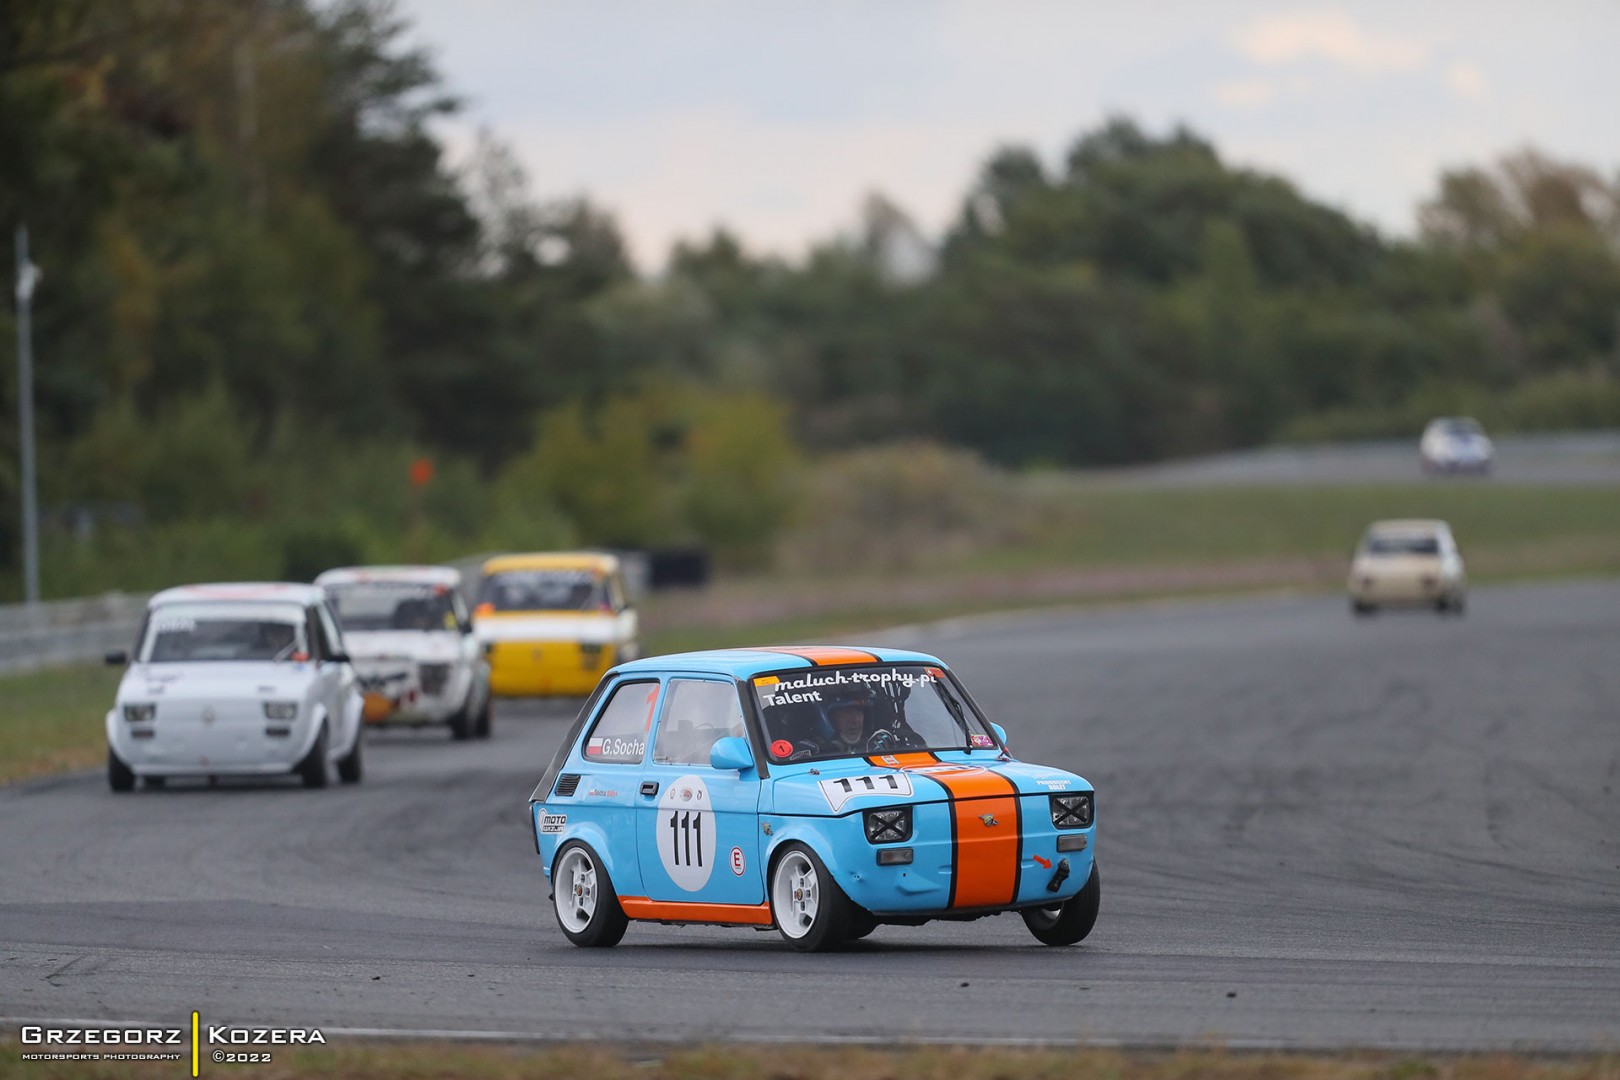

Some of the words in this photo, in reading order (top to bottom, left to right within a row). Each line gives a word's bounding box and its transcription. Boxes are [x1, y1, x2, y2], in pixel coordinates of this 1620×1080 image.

[763, 690, 822, 707] Talent
[602, 738, 645, 756] G.Socha
[833, 774, 899, 793] 111
[543, 815, 567, 825] MOTO
[670, 810, 703, 867] 111
[733, 852, 741, 867] E
